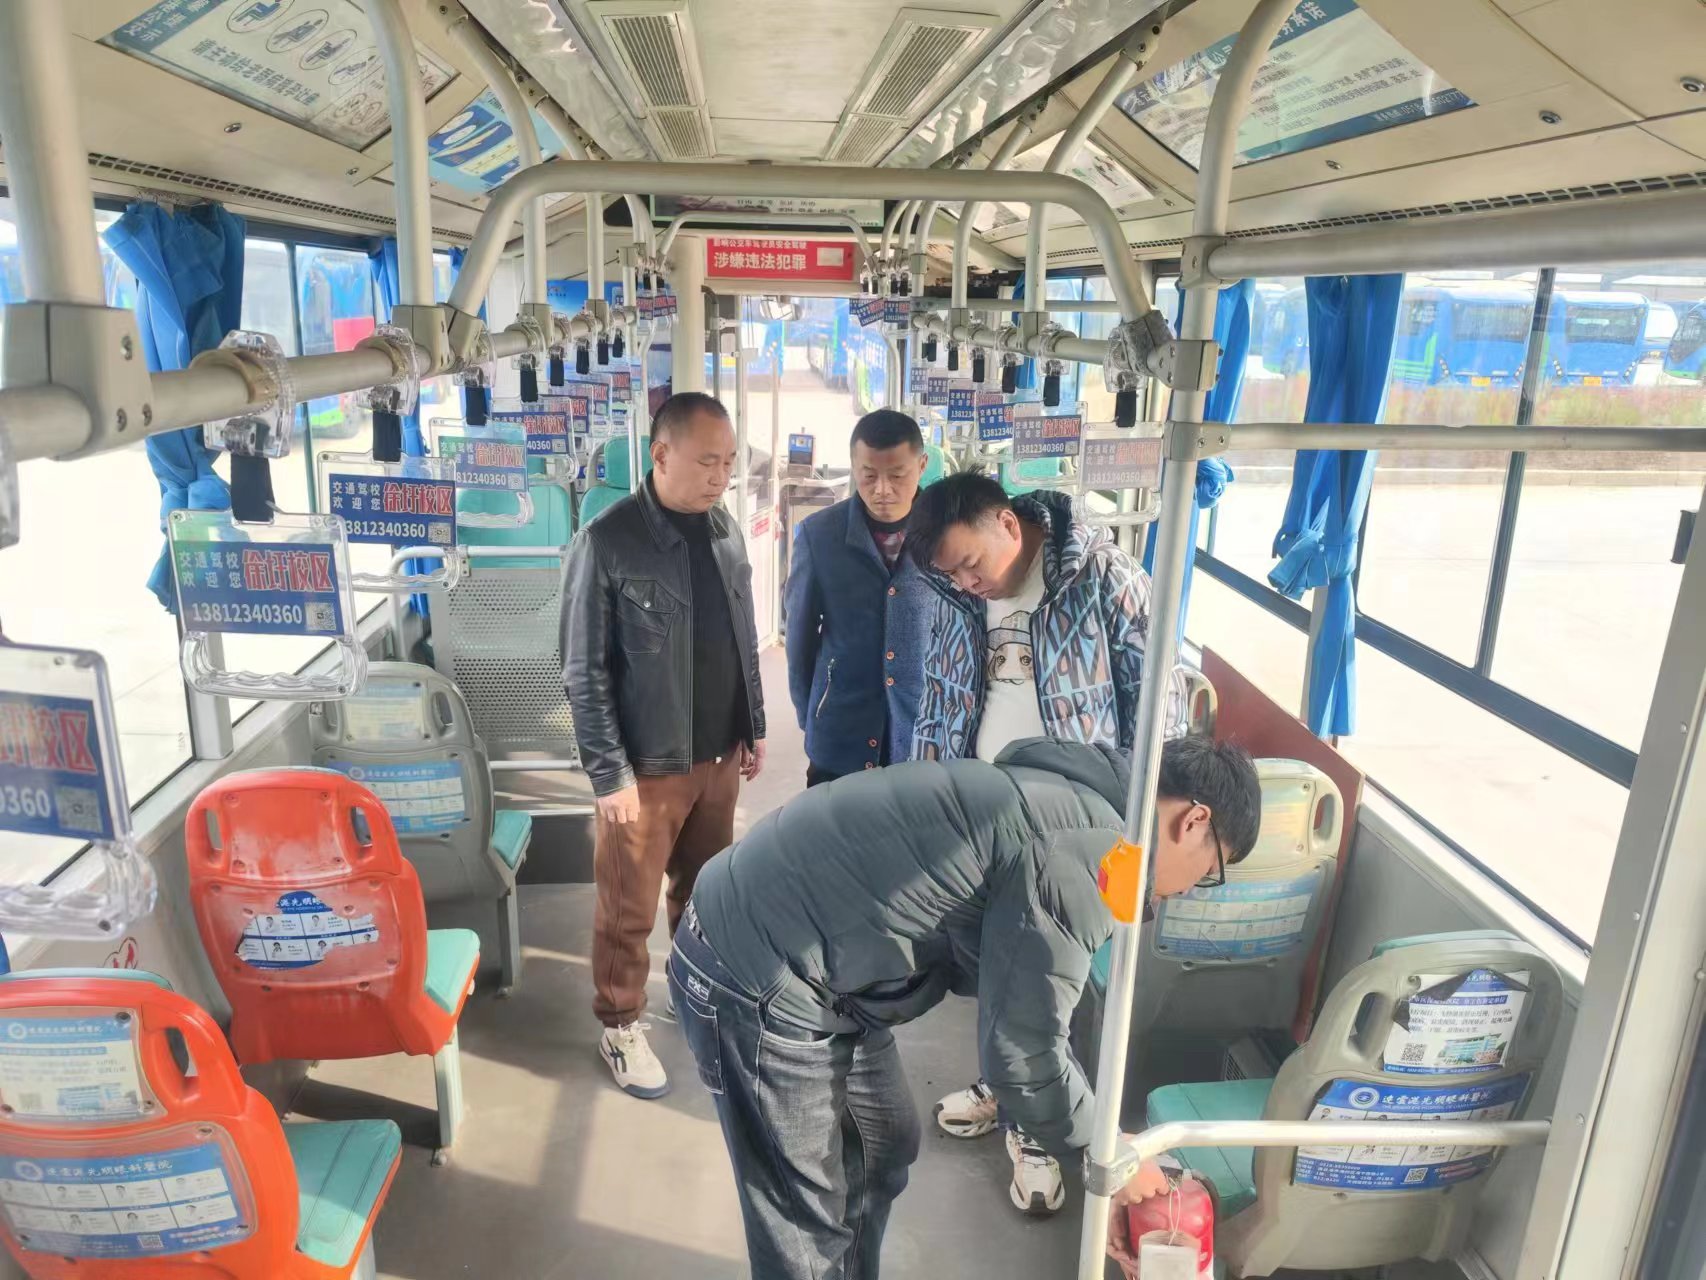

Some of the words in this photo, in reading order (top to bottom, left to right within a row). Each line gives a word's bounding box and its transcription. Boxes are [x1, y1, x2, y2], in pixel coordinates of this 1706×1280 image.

[714, 252, 807, 271] 涉嫌违法犯罪
[527, 439, 551, 450] 40360
[1016, 443, 1064, 454] 13812340360
[332, 481, 381, 496] 交通驾校
[332, 496, 381, 511] 欢迎您
[383, 481, 453, 516] 徐圩校区
[178, 551, 240, 569] 交通驾校
[182, 571, 242, 589] 欢迎您
[243, 549, 335, 593] 徐圩校区
[192, 602, 303, 625] 13812340360
